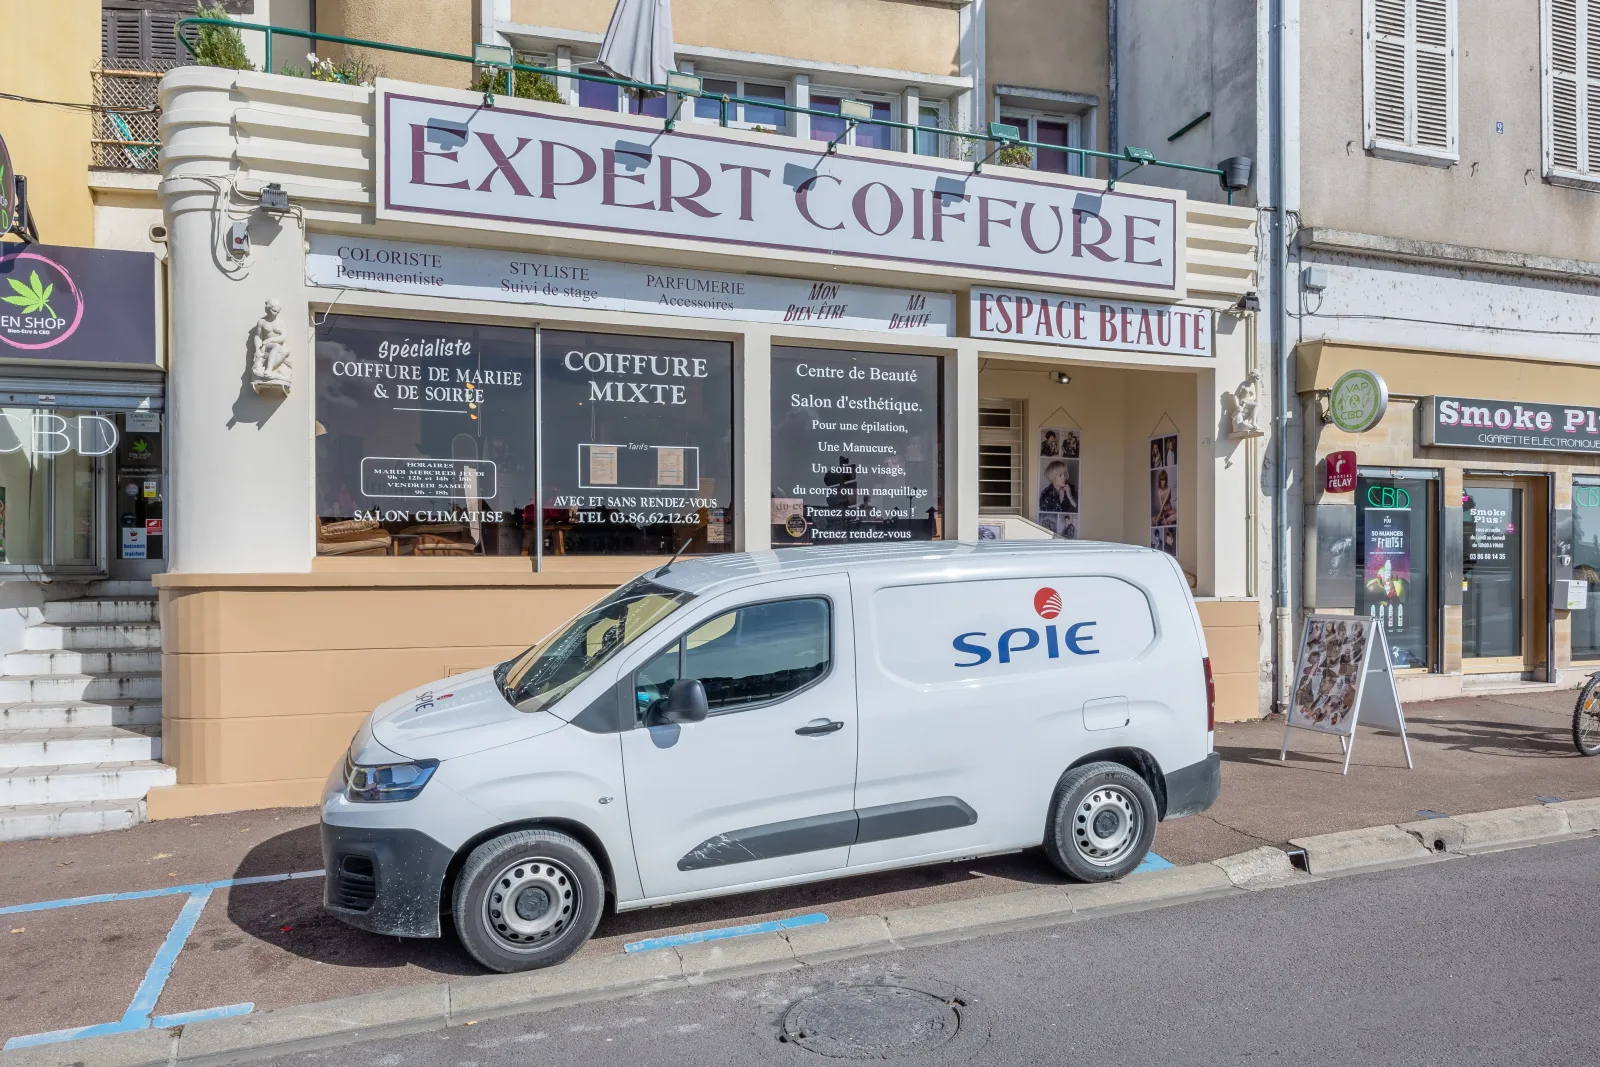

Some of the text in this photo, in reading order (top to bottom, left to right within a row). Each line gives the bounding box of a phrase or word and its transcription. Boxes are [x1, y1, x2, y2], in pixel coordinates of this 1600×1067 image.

[409, 122, 1163, 267] EXPERT COIFFURE
[337, 246, 442, 268] COLORISTE
[336, 264, 444, 286] Permanentiste
[509, 262, 590, 281] STYLISTE
[501, 278, 598, 302] Suivi de stage
[646, 274, 745, 295] PARFUMERIE
[808, 282, 840, 301] MON
[658, 294, 734, 311] Accessoires
[784, 301, 848, 322] BIEN-ÊTRE
[906, 294, 926, 312] MA
[24, 316, 66, 330] SHOP
[888, 311, 932, 330] BEAUTÉ
[979, 292, 1206, 350] ESPACE BEAUTÉ
[378, 338, 471, 362] Spécialiste
[332, 361, 422, 380] COIFFURE
[428, 366, 450, 382] DE
[564, 350, 708, 378] COIFFURE
[796, 364, 918, 382] Centre de Beauté
[374, 384, 390, 398] &
[396, 384, 419, 400] DE
[588, 380, 687, 405] MIXTE
[1346, 382, 1369, 394] VAP
[791, 394, 922, 414] Salon d'esthétique.
[1340, 409, 1364, 420] CBD
[1439, 400, 1600, 434] Smoke Pl
[812, 420, 908, 434] Pour une épilation,
[628, 442, 648, 450] Tarifs
[818, 442, 896, 454] Une Manucure,
[1478, 434, 1600, 449] CIGARETTE ELECTRONIQUE
[812, 464, 906, 476] Un soin du visage,
[792, 485, 806, 495] du
[809, 487, 838, 497] corps
[840, 487, 854, 495] ou
[872, 486, 928, 498] maquillage
[1368, 486, 1410, 508] CBD
[554, 496, 718, 508] AVEC ET SANS RENDEZ-VOUS
[354, 510, 504, 523] SALON CLIMATISE
[576, 512, 606, 523] TEL
[610, 512, 700, 524] 03.86.62.12.62
[806, 506, 842, 516] Prenez
[844, 507, 866, 517] soin
[869, 507, 882, 517] de
[884, 508, 908, 517] vous
[1470, 508, 1506, 516] Smoke
[811, 528, 912, 538] Prenez rendez-vous
[952, 621, 1100, 667] SPIE
[416, 690, 434, 712] SPIE
